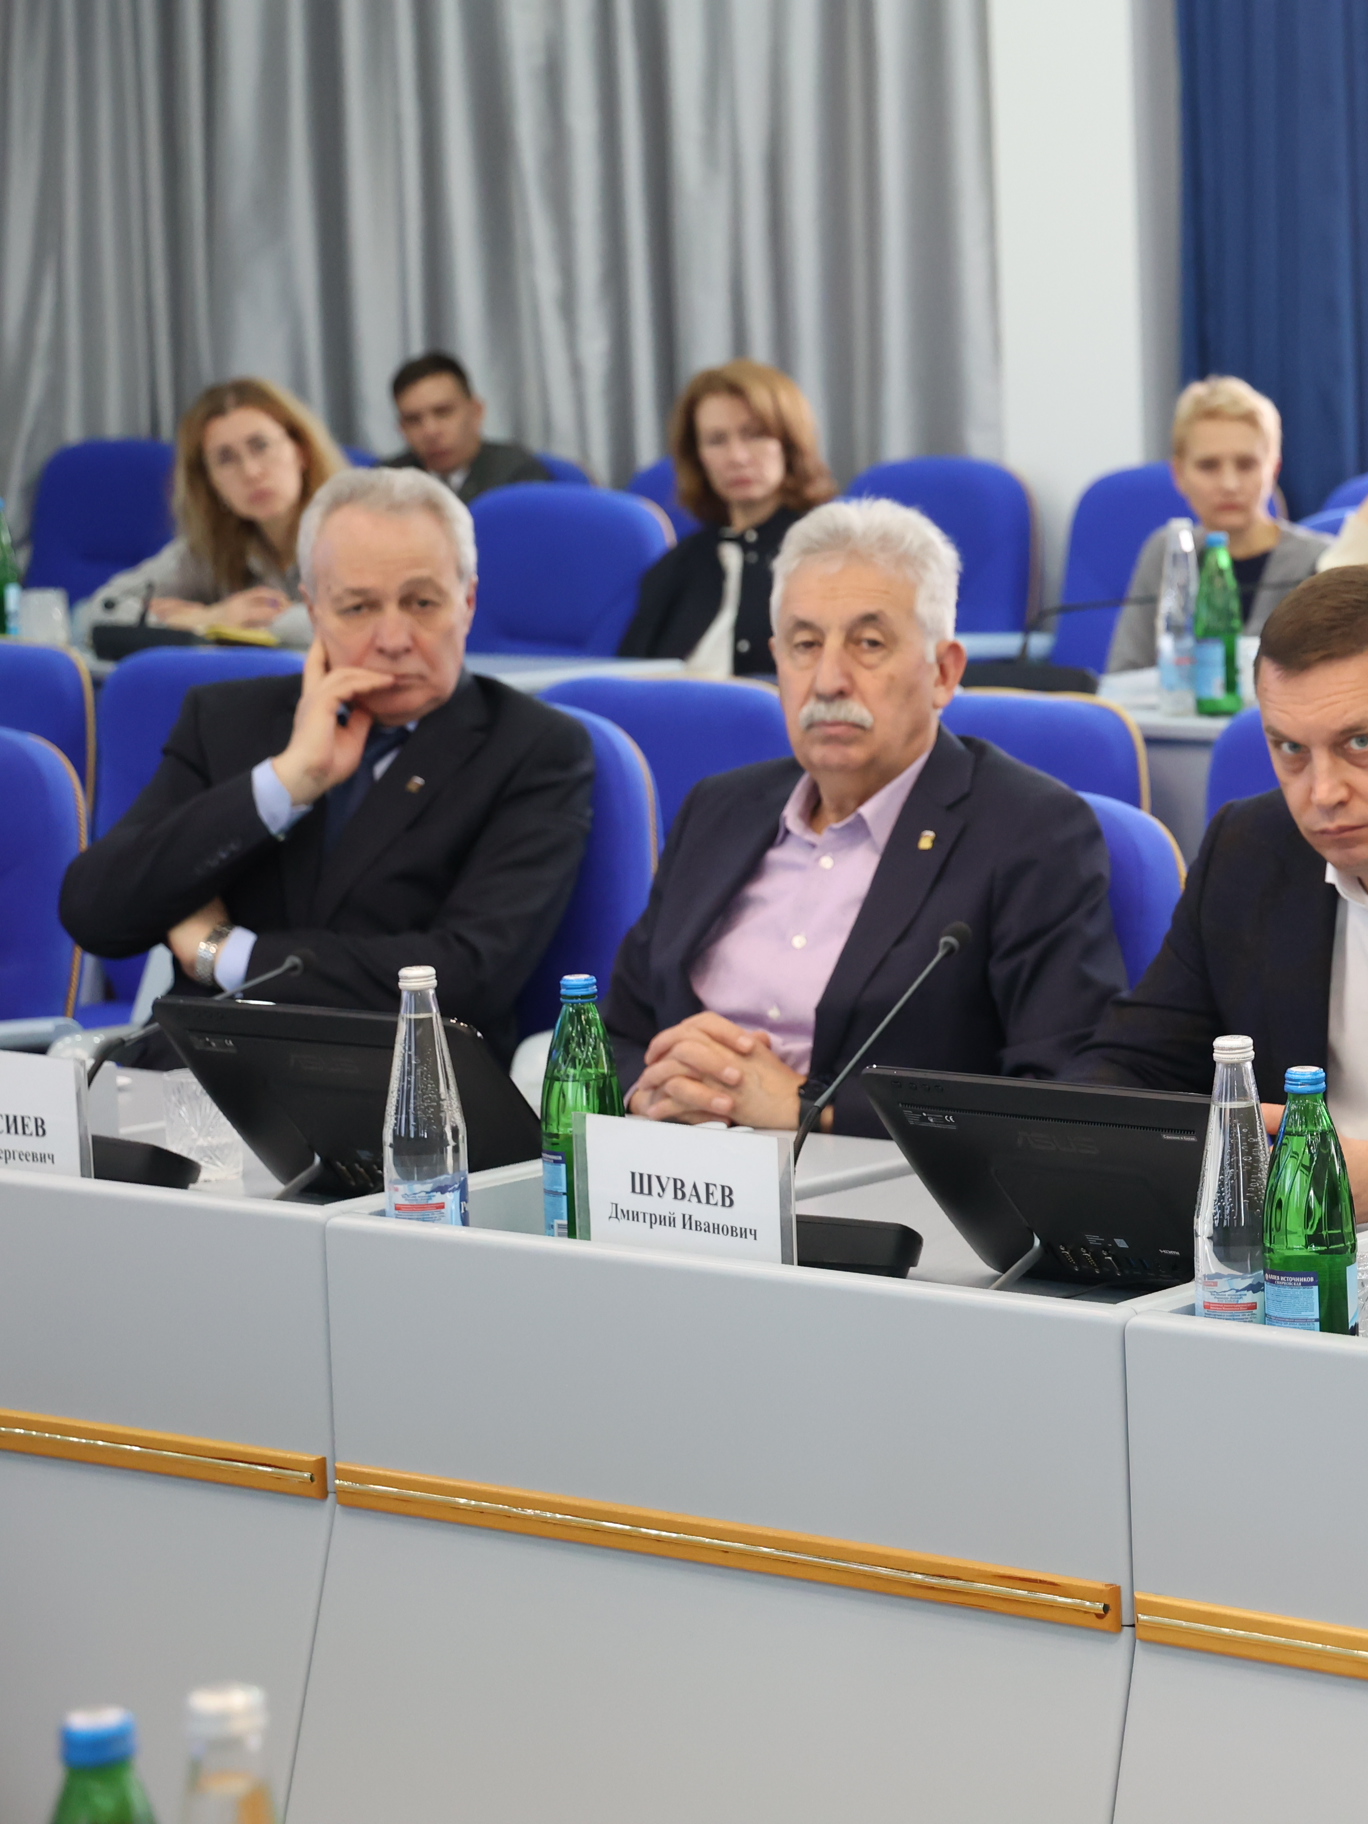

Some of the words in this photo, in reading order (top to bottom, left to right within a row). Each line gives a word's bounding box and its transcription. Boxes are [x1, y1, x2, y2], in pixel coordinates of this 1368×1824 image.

[630, 1171, 735, 1208] ШУВАЕВ
[608, 1202, 677, 1229] Дмитрий
[681, 1212, 758, 1241] Иванович
